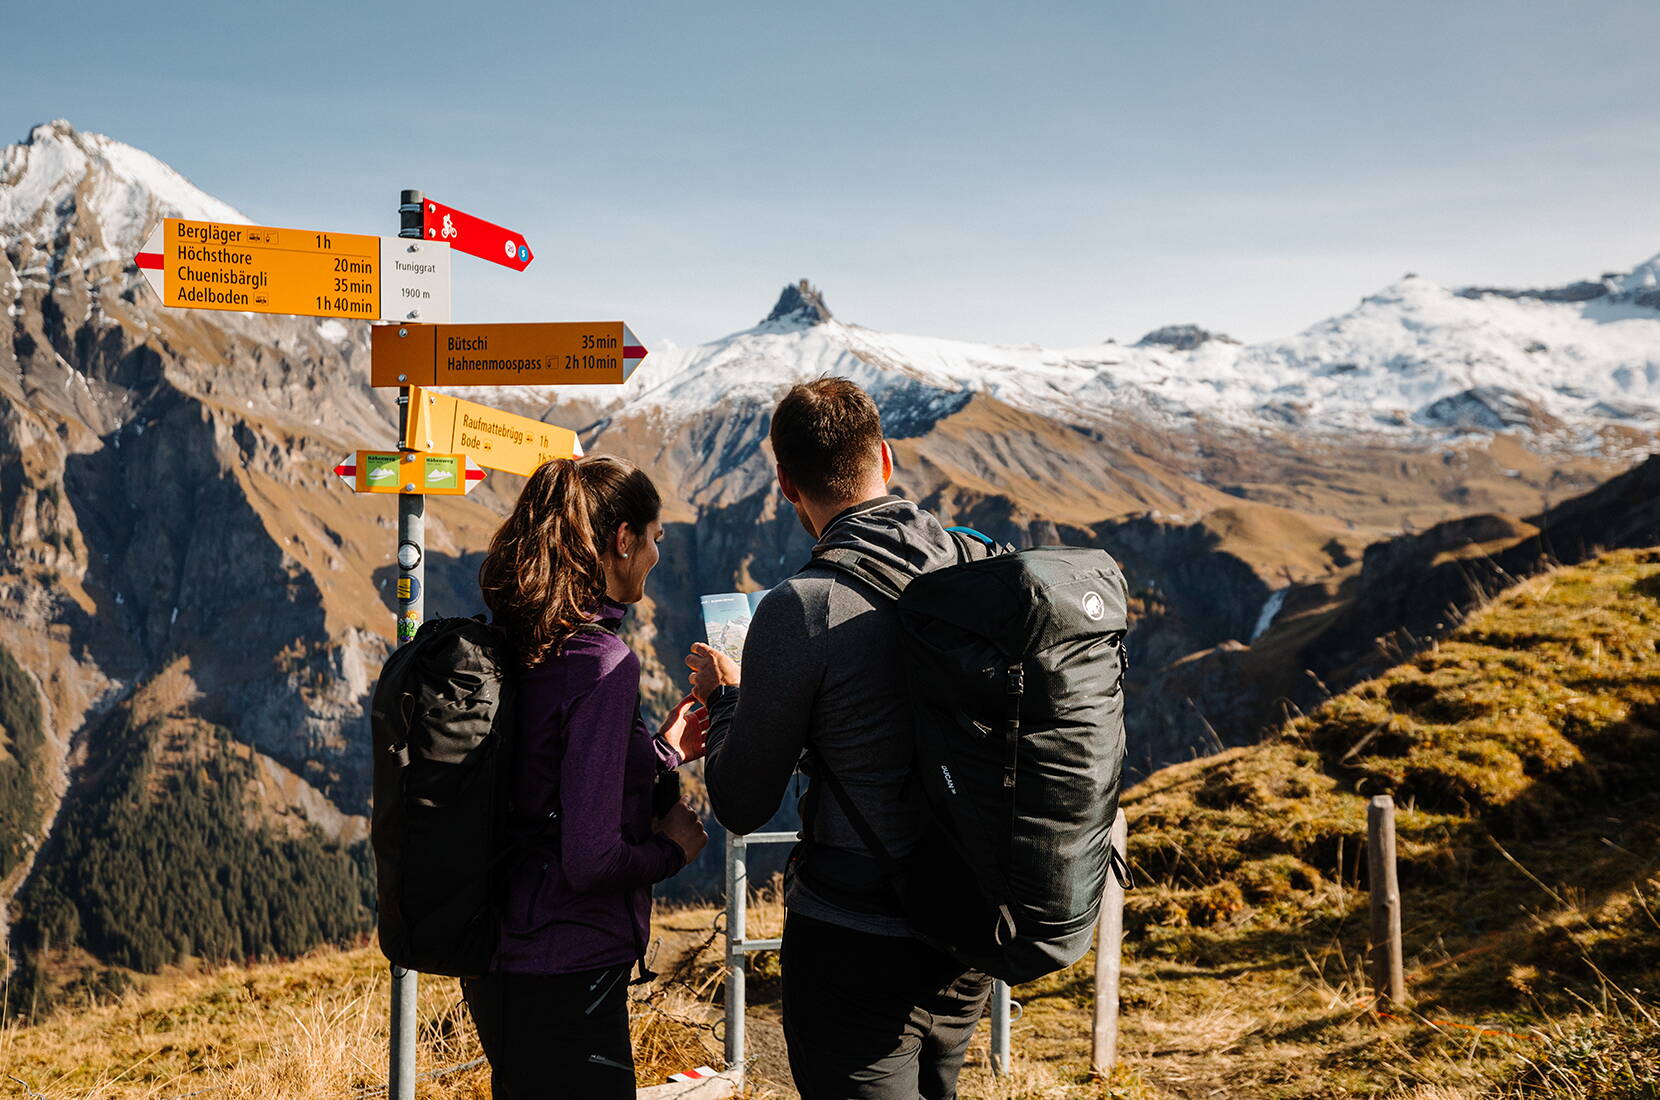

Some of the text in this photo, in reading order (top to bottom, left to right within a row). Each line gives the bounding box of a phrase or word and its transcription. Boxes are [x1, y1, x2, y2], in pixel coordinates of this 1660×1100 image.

[177, 222, 242, 245] Bergläger
[177, 245, 252, 265] Höchsthore
[395, 260, 436, 275] Truniggrat
[177, 266, 267, 290] Chuenisbärgli
[177, 286, 249, 305] Adelboden
[401, 287, 431, 299] 1900 m
[447, 336, 488, 351] Bütschi
[447, 357, 542, 374] Hahnenmoospass
[461, 433, 481, 450] Bode
